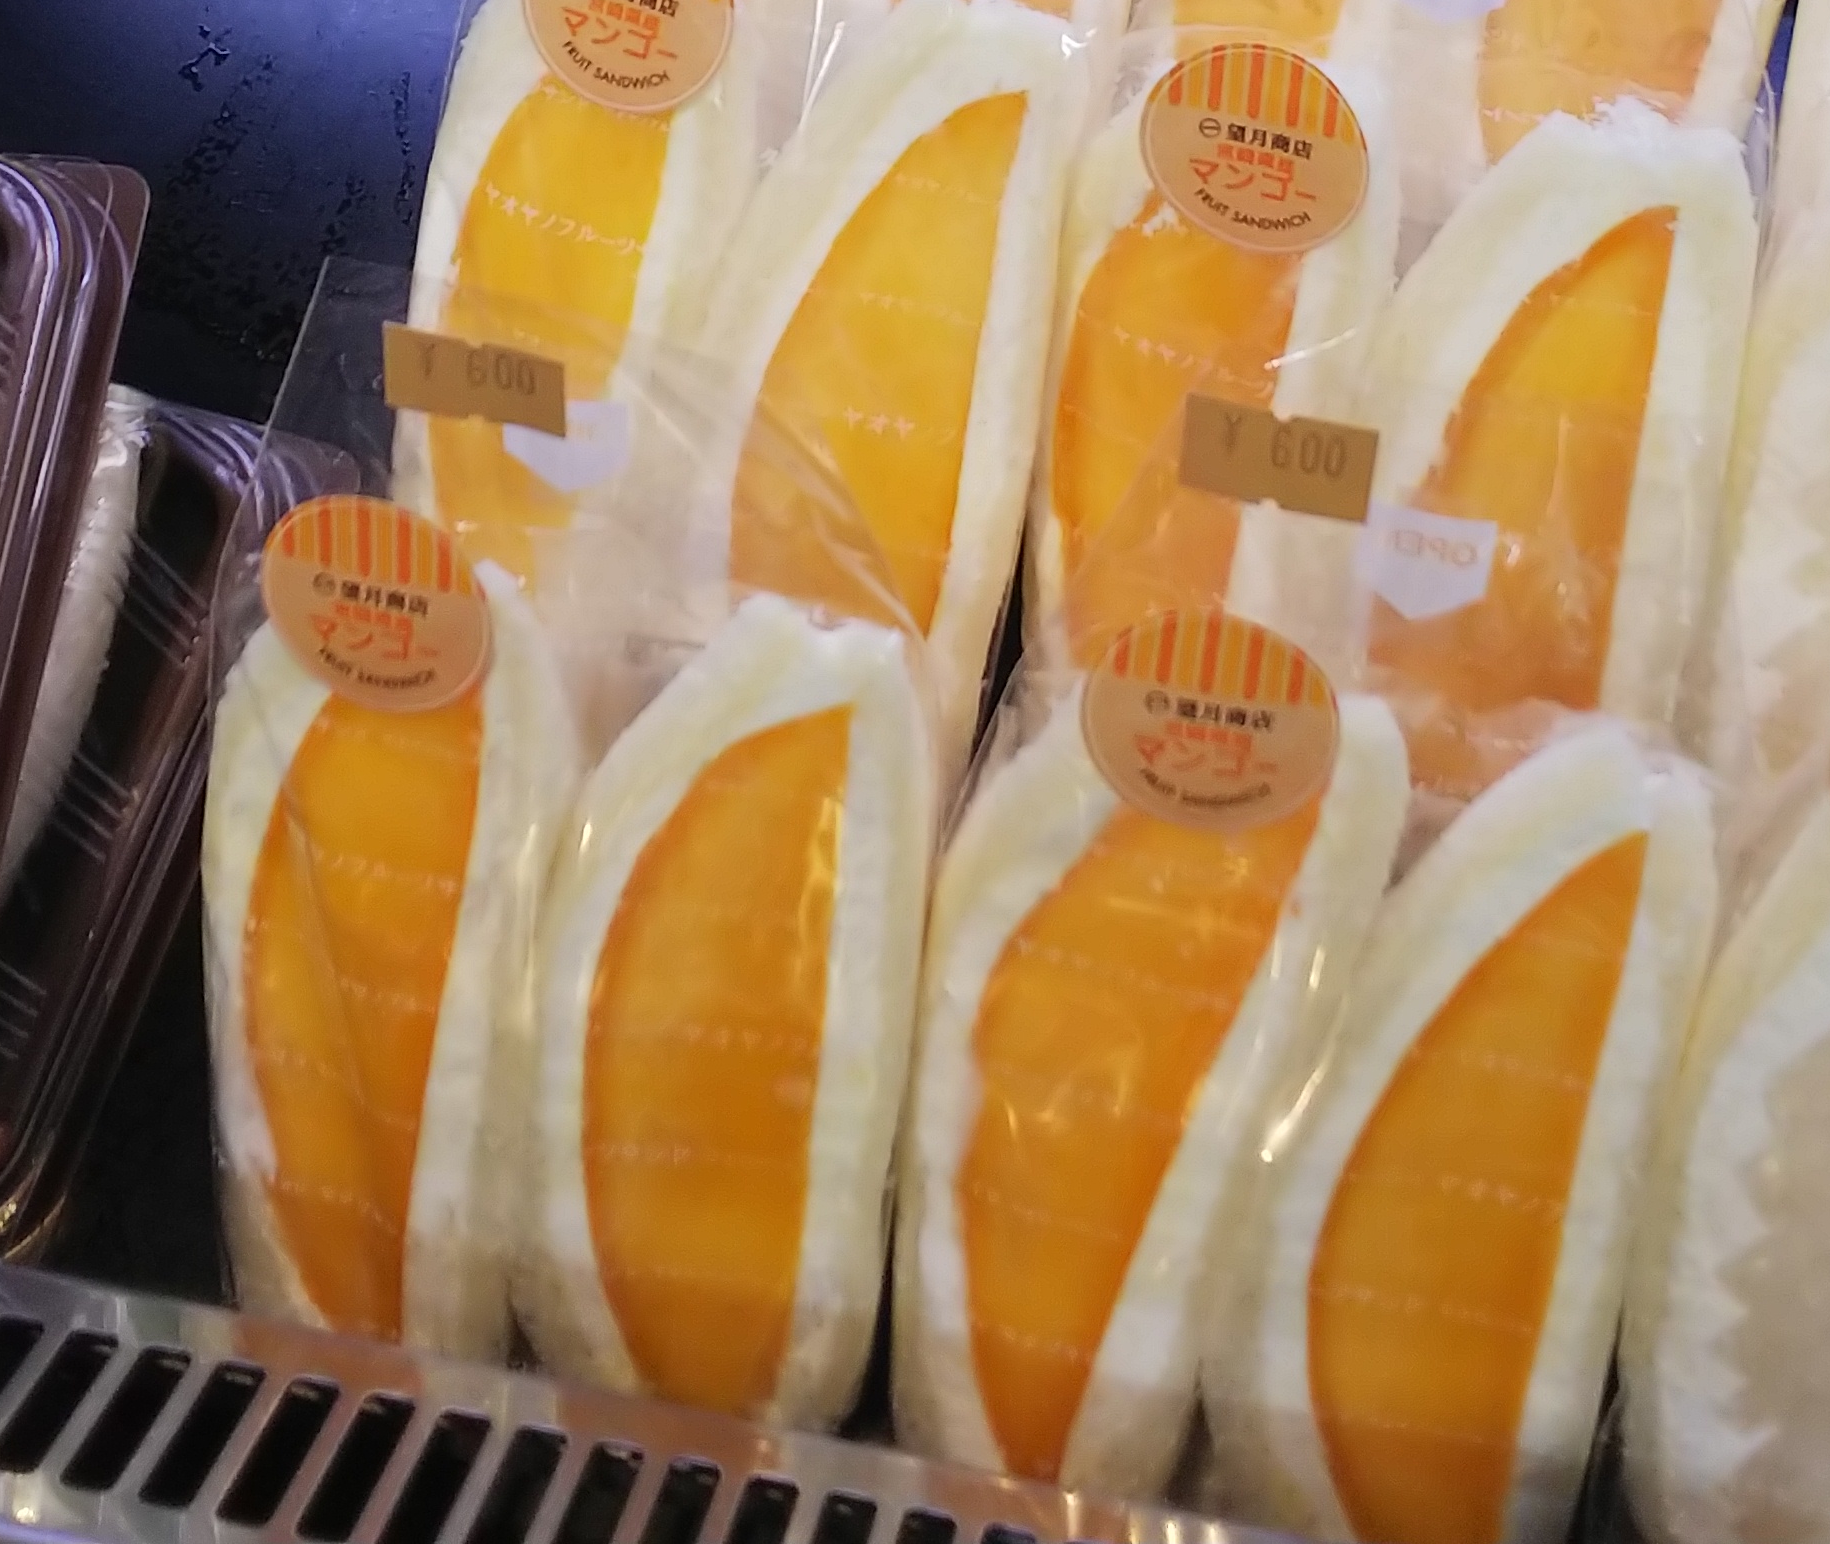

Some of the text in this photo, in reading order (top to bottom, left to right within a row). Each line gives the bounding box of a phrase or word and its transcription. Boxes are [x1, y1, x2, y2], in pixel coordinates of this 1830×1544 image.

[561, 4, 678, 60] マンゴー
[562, 39, 671, 91] FRUIT SANDWICH
[1226, 122, 1313, 161] 望月商店
[1189, 157, 1317, 202] マンゴー
[1195, 187, 1311, 232] FRUIT SANDWICH
[466, 352, 537, 397] 600
[1270, 428, 1348, 479] 600
[309, 613, 441, 663] マンゴー
[1135, 732, 1280, 779] マンゴー
